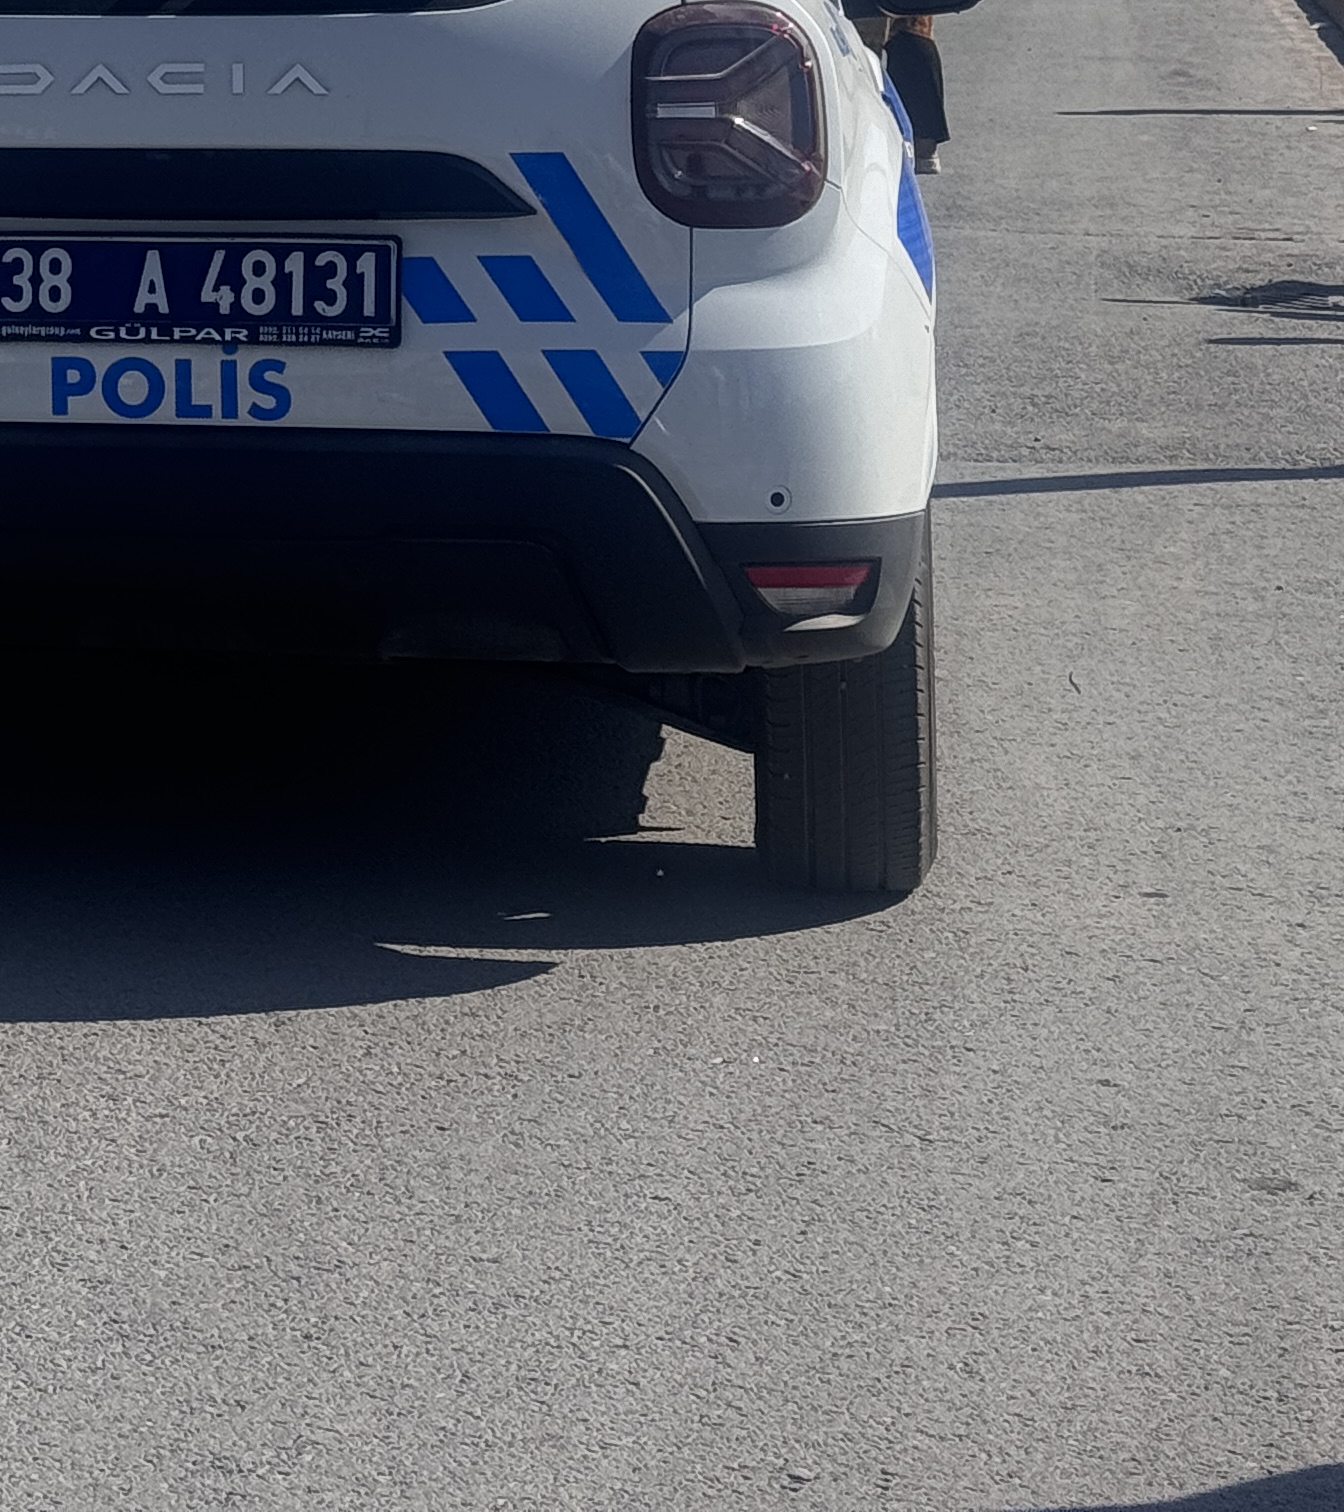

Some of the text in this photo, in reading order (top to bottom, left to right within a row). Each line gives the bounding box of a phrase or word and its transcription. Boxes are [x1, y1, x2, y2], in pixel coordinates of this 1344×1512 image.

[0, 246, 377, 318] 38 A 48131
[89, 323, 249, 342] GÜLPAR
[50, 343, 292, 422] POLİS
